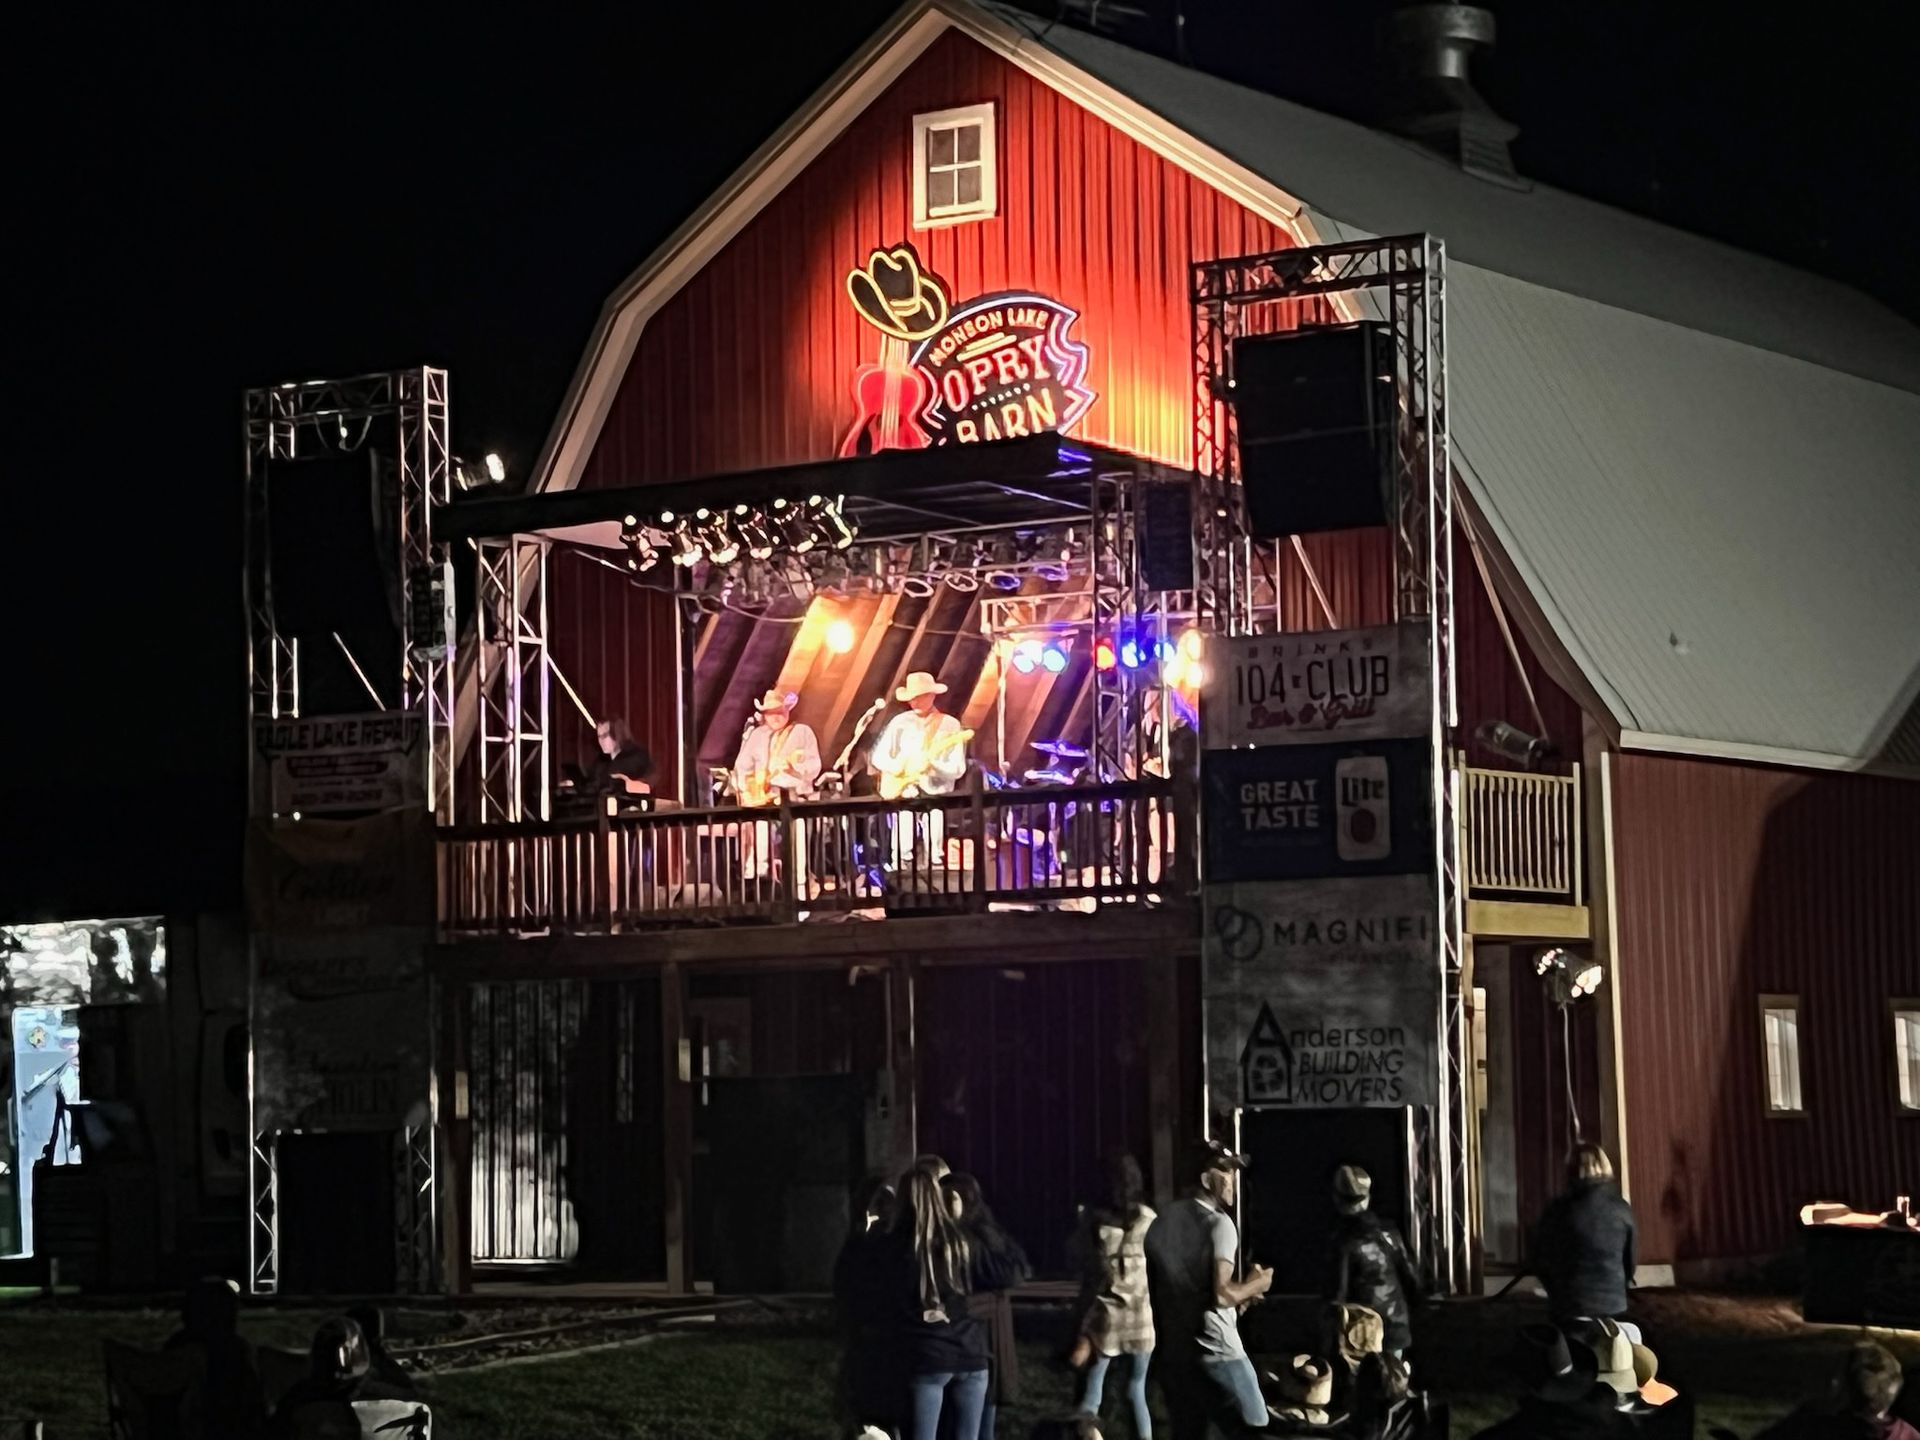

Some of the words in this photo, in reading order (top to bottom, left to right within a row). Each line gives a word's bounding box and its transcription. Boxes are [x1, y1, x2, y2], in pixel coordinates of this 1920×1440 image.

[929, 310, 1003, 367] MONSON
[1007, 307, 1049, 329] LAKE
[943, 335, 1050, 412] OPRY
[956, 388, 1056, 443] BARN
[1240, 779, 1319, 804] GREAT
[1240, 804, 1320, 831] TASTE
[1273, 915, 1427, 945] MAGNIFI
[1299, 1050, 1404, 1076] BUILDING
[1296, 1076, 1403, 1103] MOVERS
